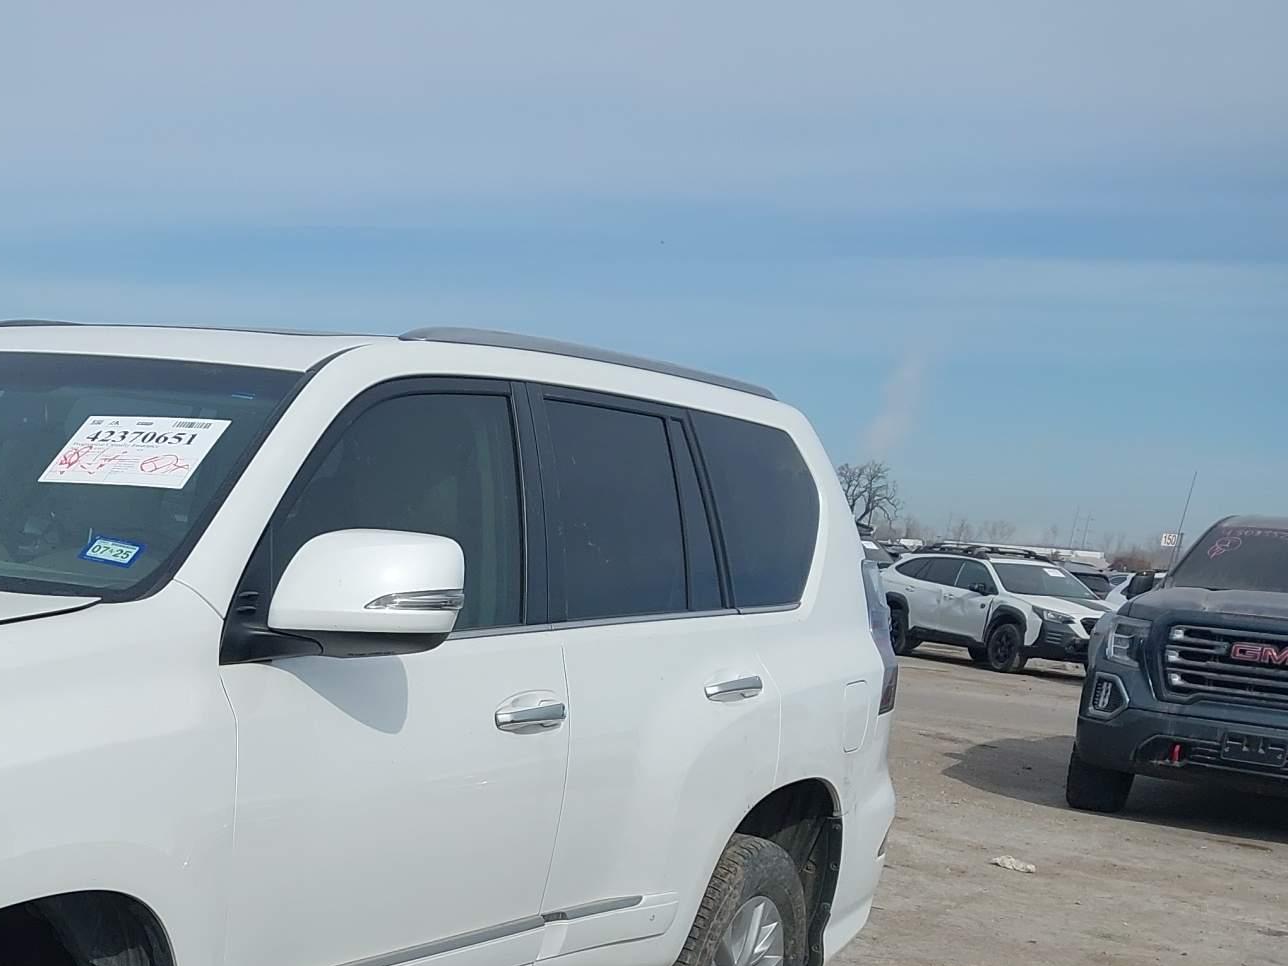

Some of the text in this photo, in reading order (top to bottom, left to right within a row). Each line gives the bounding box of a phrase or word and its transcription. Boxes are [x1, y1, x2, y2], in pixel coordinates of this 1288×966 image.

[85, 430, 198, 446] 42370651
[1162, 534, 1177, 545] 150
[91, 544, 110, 555] 07
[112, 548, 132, 560] 25
